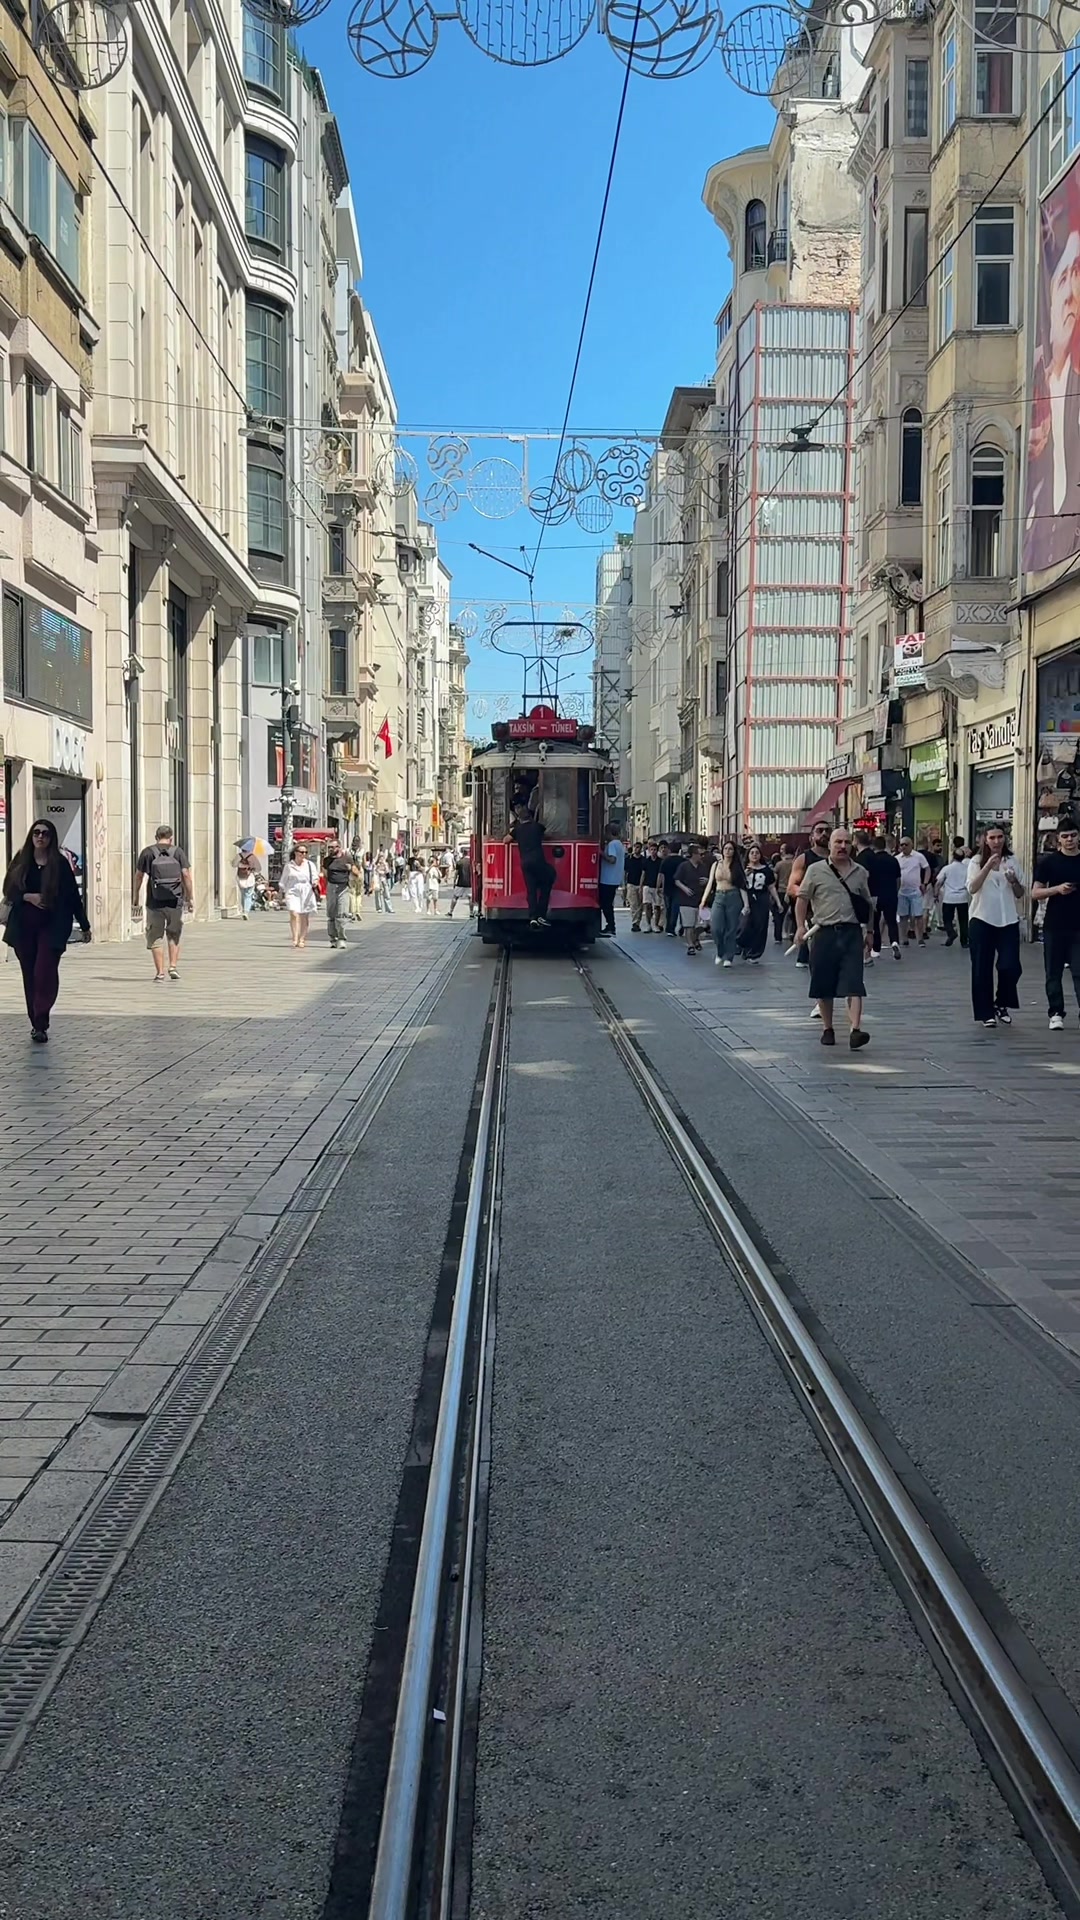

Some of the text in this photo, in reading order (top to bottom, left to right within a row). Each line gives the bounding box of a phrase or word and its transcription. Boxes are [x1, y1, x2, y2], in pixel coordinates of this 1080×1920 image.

[896, 633, 926, 645] FAL
[539, 706, 544, 719] 1
[509, 721, 535, 733] TAKSİM
[551, 721, 573, 733] TÜNEL
[486, 853, 496, 864] 47
